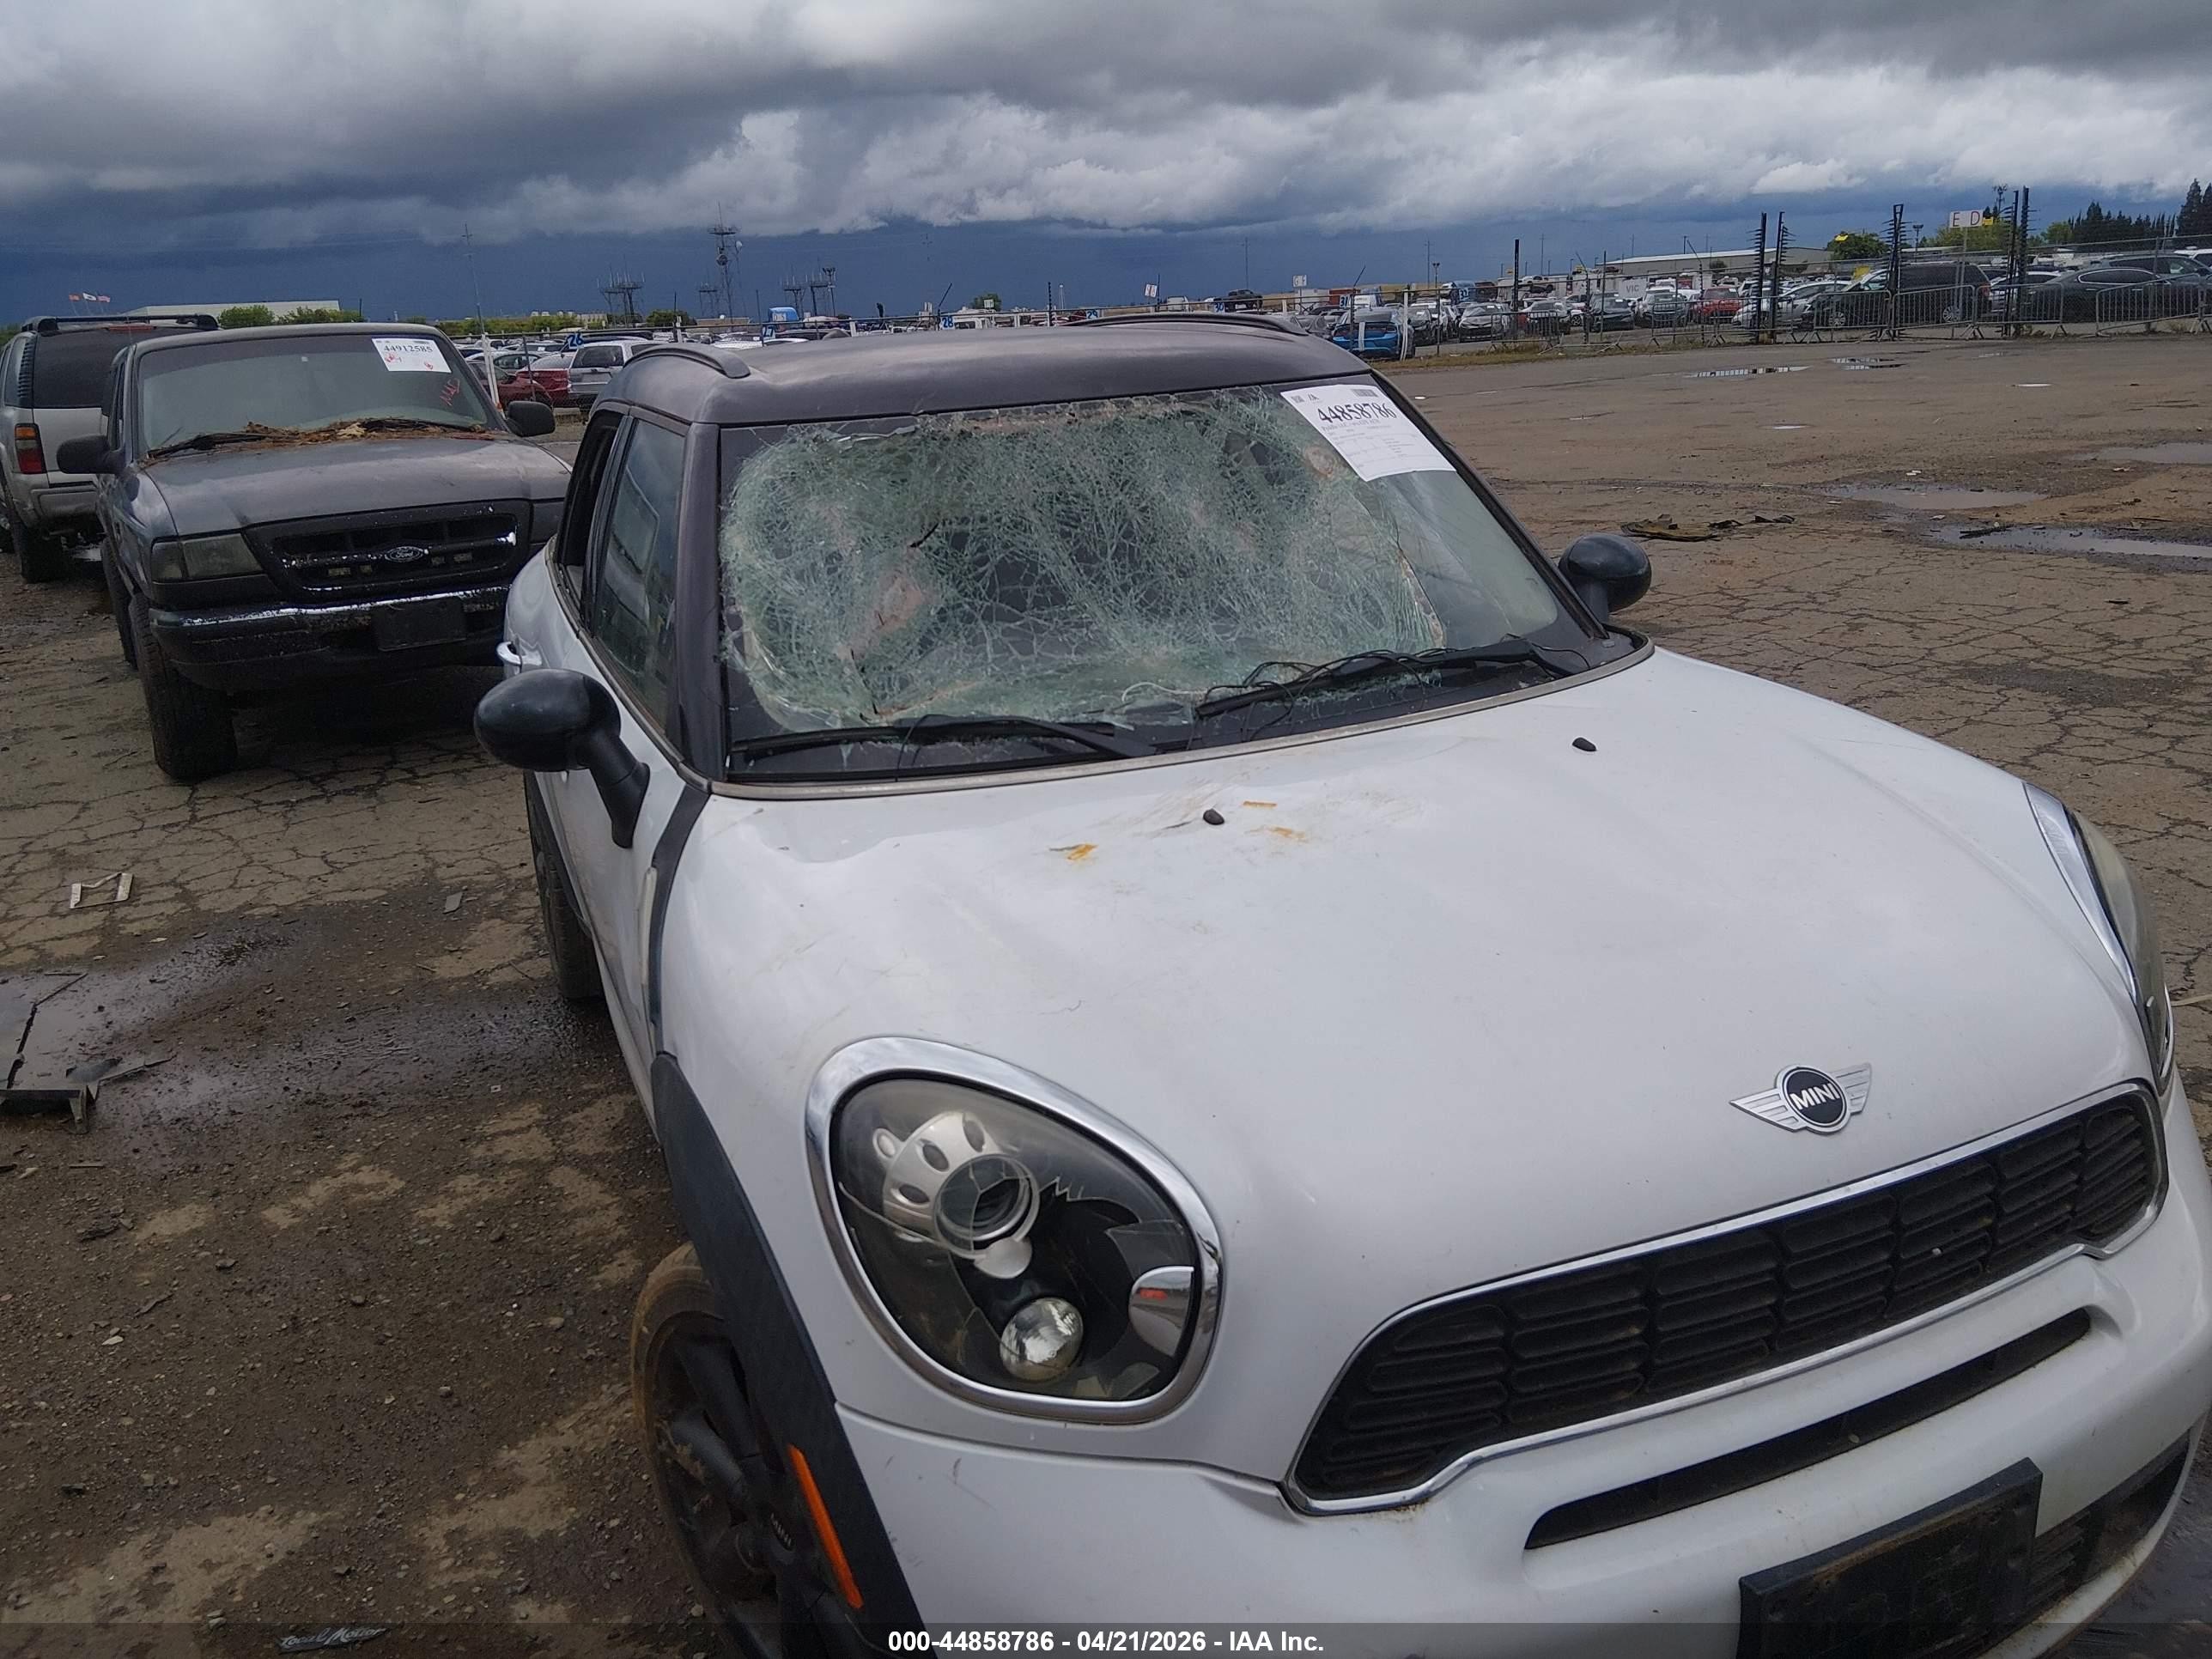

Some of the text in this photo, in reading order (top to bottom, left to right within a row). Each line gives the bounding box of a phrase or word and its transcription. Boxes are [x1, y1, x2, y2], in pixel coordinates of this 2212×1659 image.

[1953, 210, 1980, 228] E D
[1340, 296, 1348, 307] 31
[942, 315, 954, 328] 28
[1086, 310, 1098, 319] 29
[567, 331, 584, 347] 26
[1317, 403, 1397, 423] 44858786
[1790, 1082, 1841, 1110] MINI
